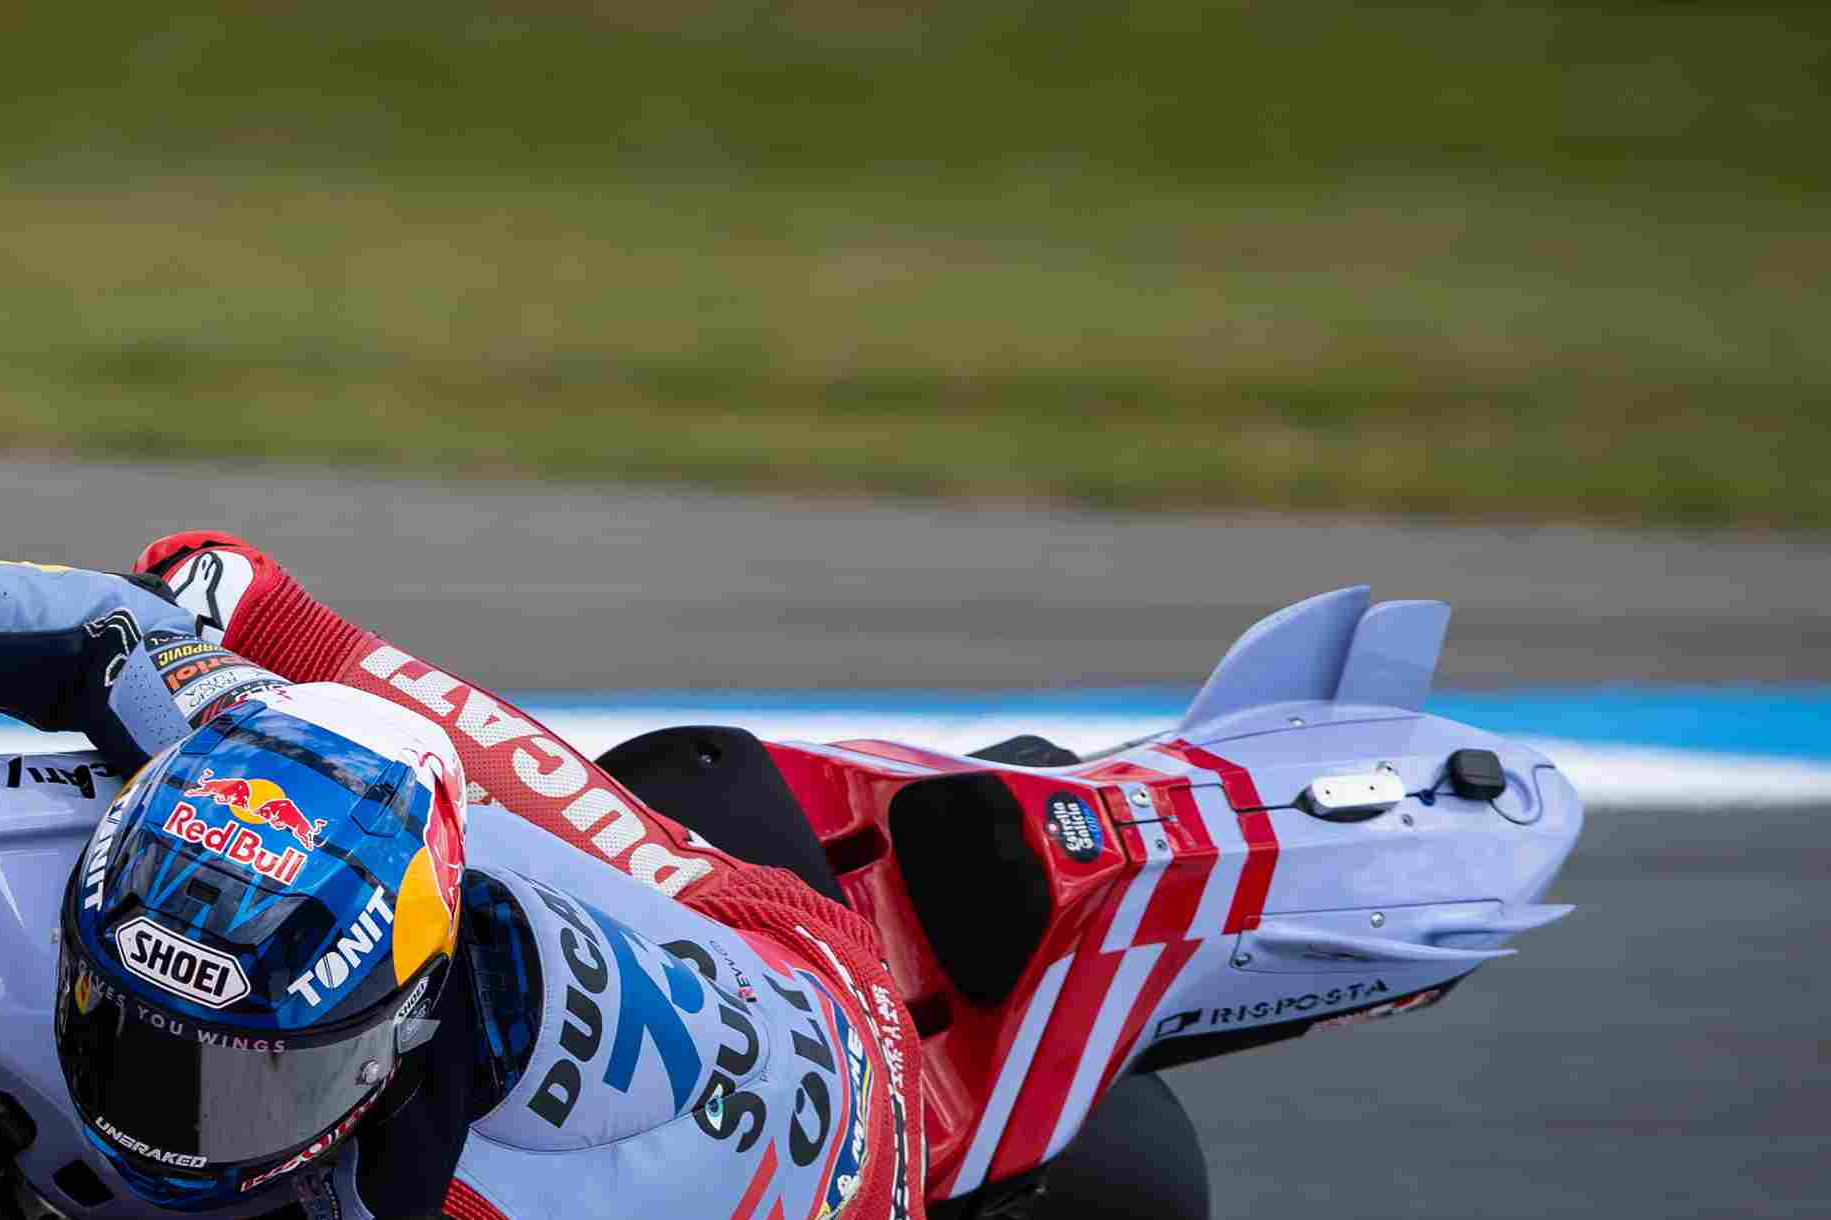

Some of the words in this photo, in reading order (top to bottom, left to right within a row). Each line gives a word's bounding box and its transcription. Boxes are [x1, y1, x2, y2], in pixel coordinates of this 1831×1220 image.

[358, 645, 715, 900] DUCATI
[128, 929, 231, 998] SHOEI
[287, 886, 395, 1008] TONIT
[136, 1005, 185, 1037] YOU
[196, 1029, 286, 1054] WINGS
[1210, 977, 1387, 1026] RISPOSTA
